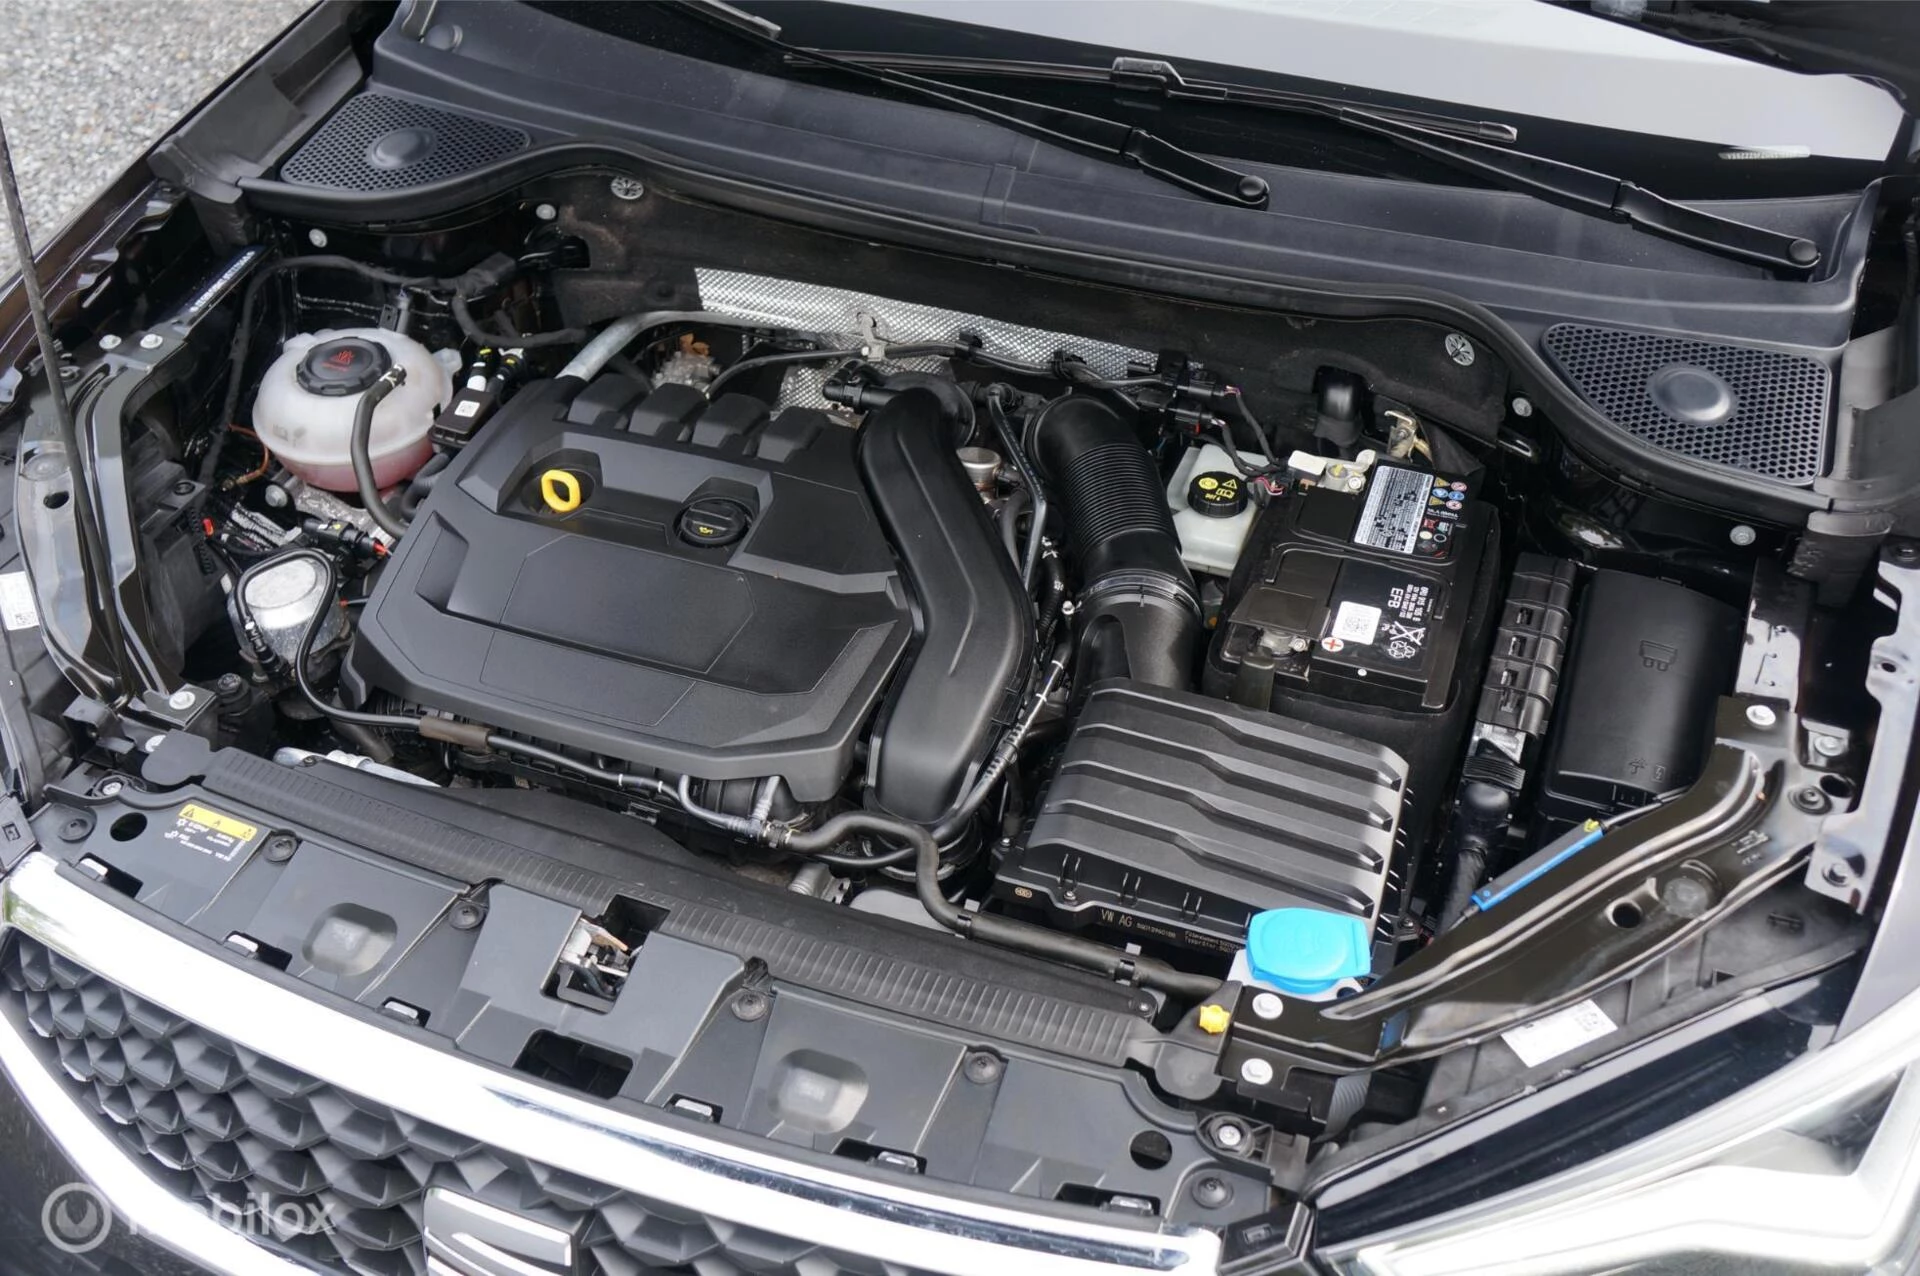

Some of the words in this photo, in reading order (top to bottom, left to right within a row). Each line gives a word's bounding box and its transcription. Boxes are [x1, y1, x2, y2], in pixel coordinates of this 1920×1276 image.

[1387, 587, 1404, 609] EFB
[1101, 908, 1114, 923] VW
[1118, 914, 1133, 928] AG
